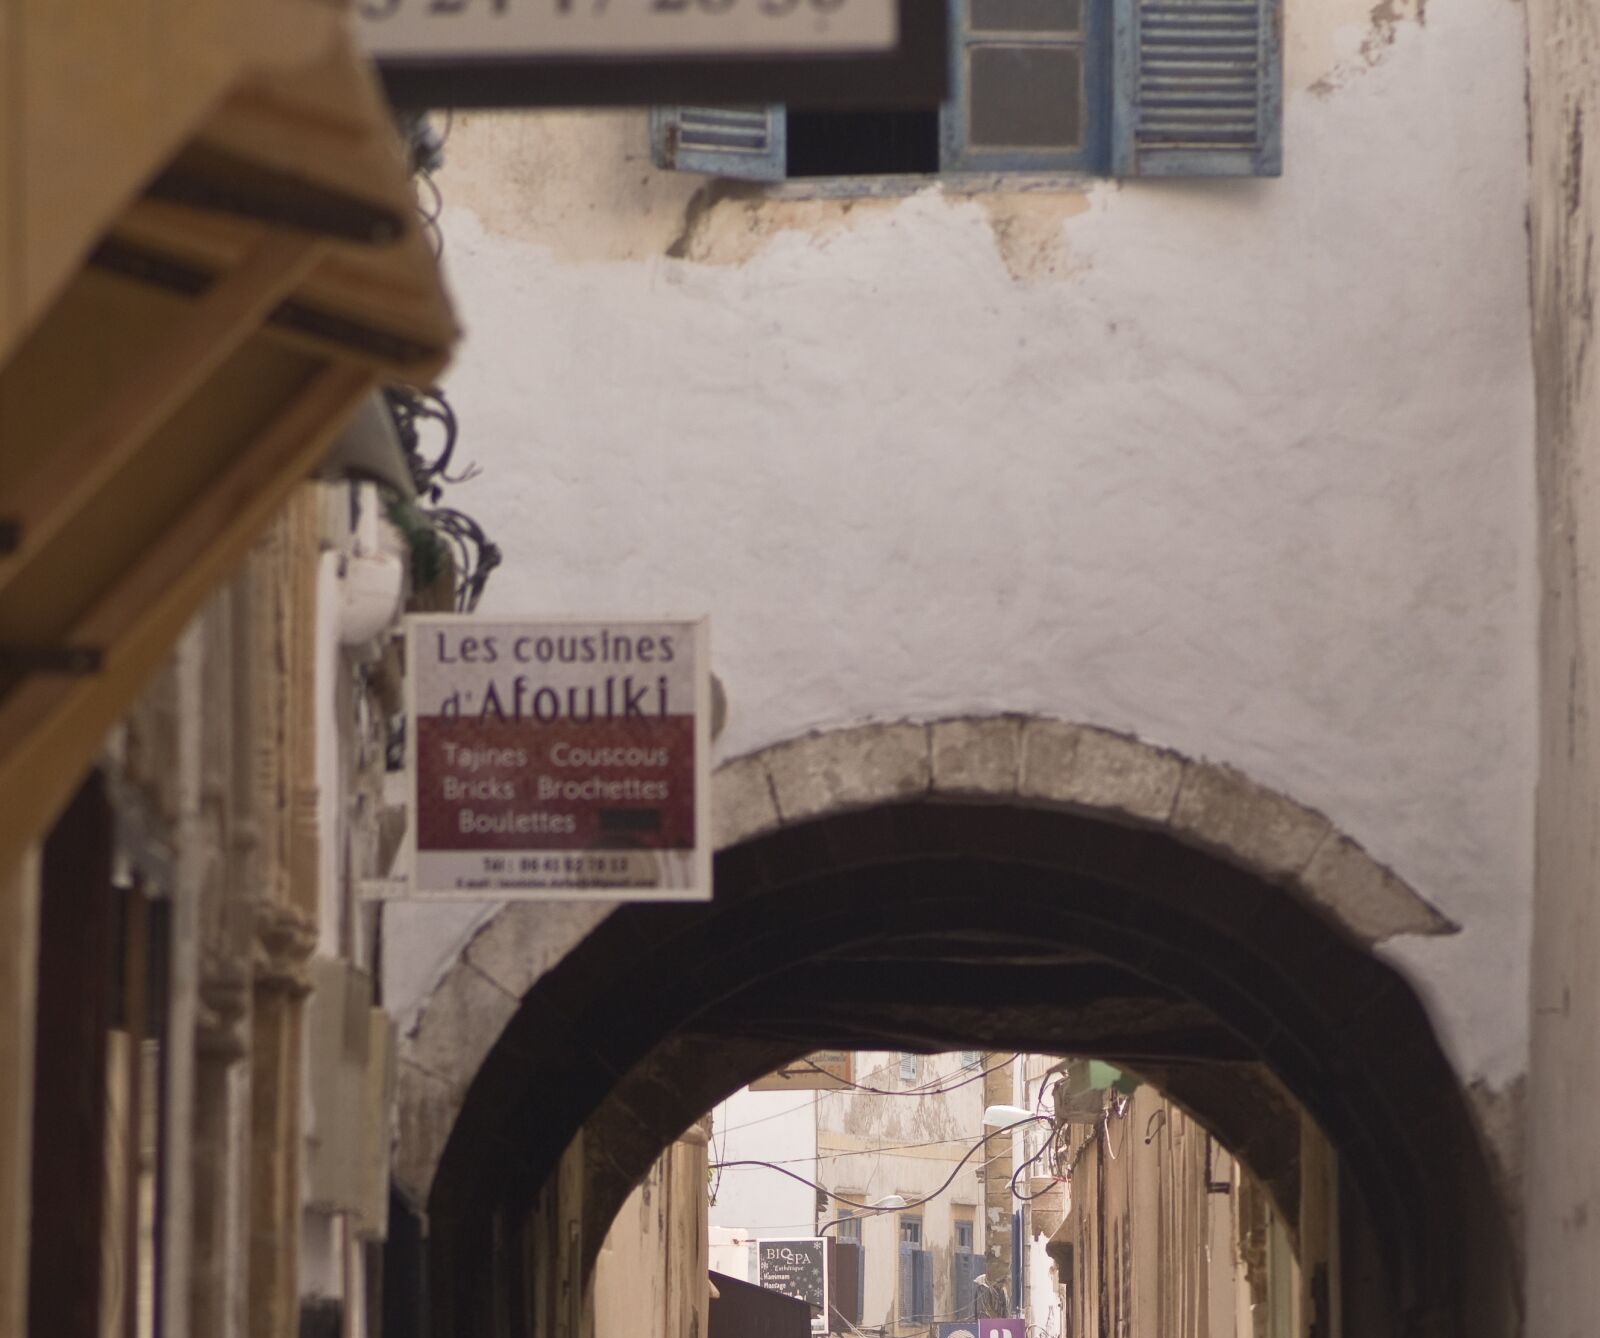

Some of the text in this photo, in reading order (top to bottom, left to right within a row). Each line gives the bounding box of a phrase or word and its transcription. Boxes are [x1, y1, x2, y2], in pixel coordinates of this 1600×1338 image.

[436, 629, 675, 663] Les cousines
[443, 742, 669, 771] Tajines Couscous
[443, 775, 669, 801] Bricks Brochettes
[458, 808, 576, 833] Boulettes
